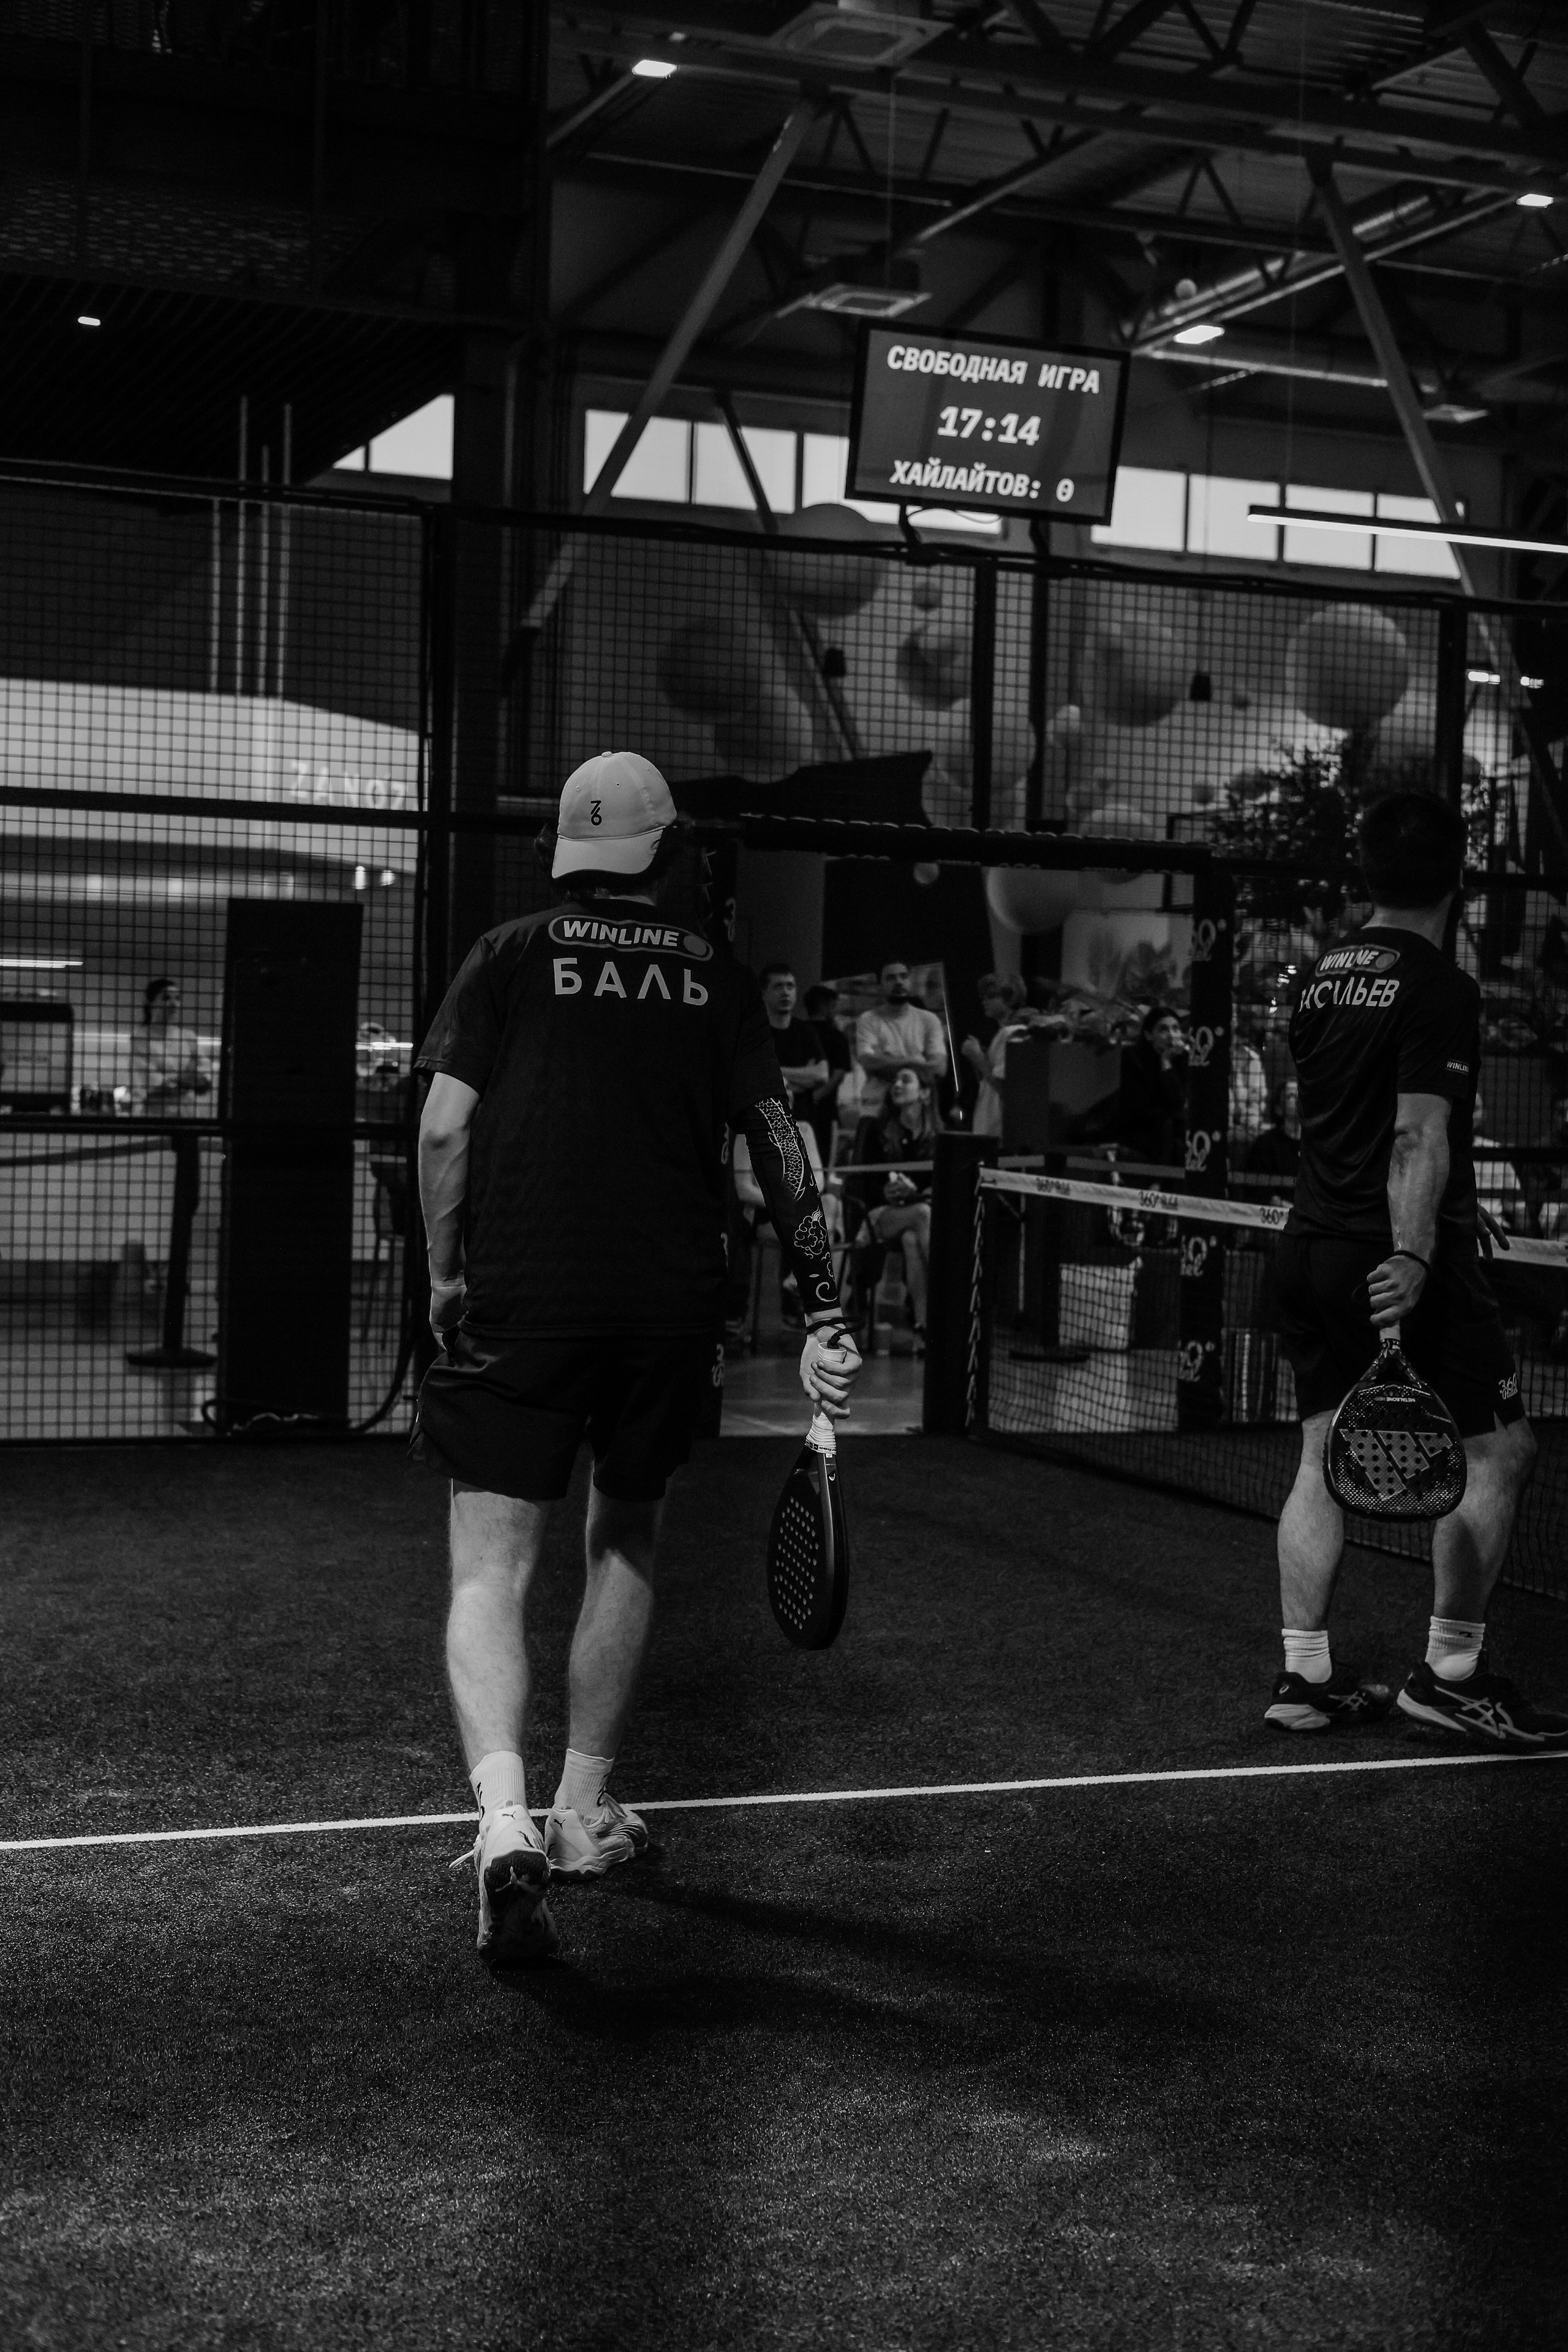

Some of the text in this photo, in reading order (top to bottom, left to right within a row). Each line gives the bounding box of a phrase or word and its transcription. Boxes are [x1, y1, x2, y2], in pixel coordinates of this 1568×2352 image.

[887, 345, 1100, 394] СВОБОДНАЯ ИГРА
[937, 405, 1042, 447] 17:14
[889, 456, 1075, 502] ХАЙЛАЙТОВ: 0
[563, 921, 679, 947] WINLINE
[552, 957, 709, 1006] БАЛЬ
[1447, 1060, 1469, 1072] WINLIN
